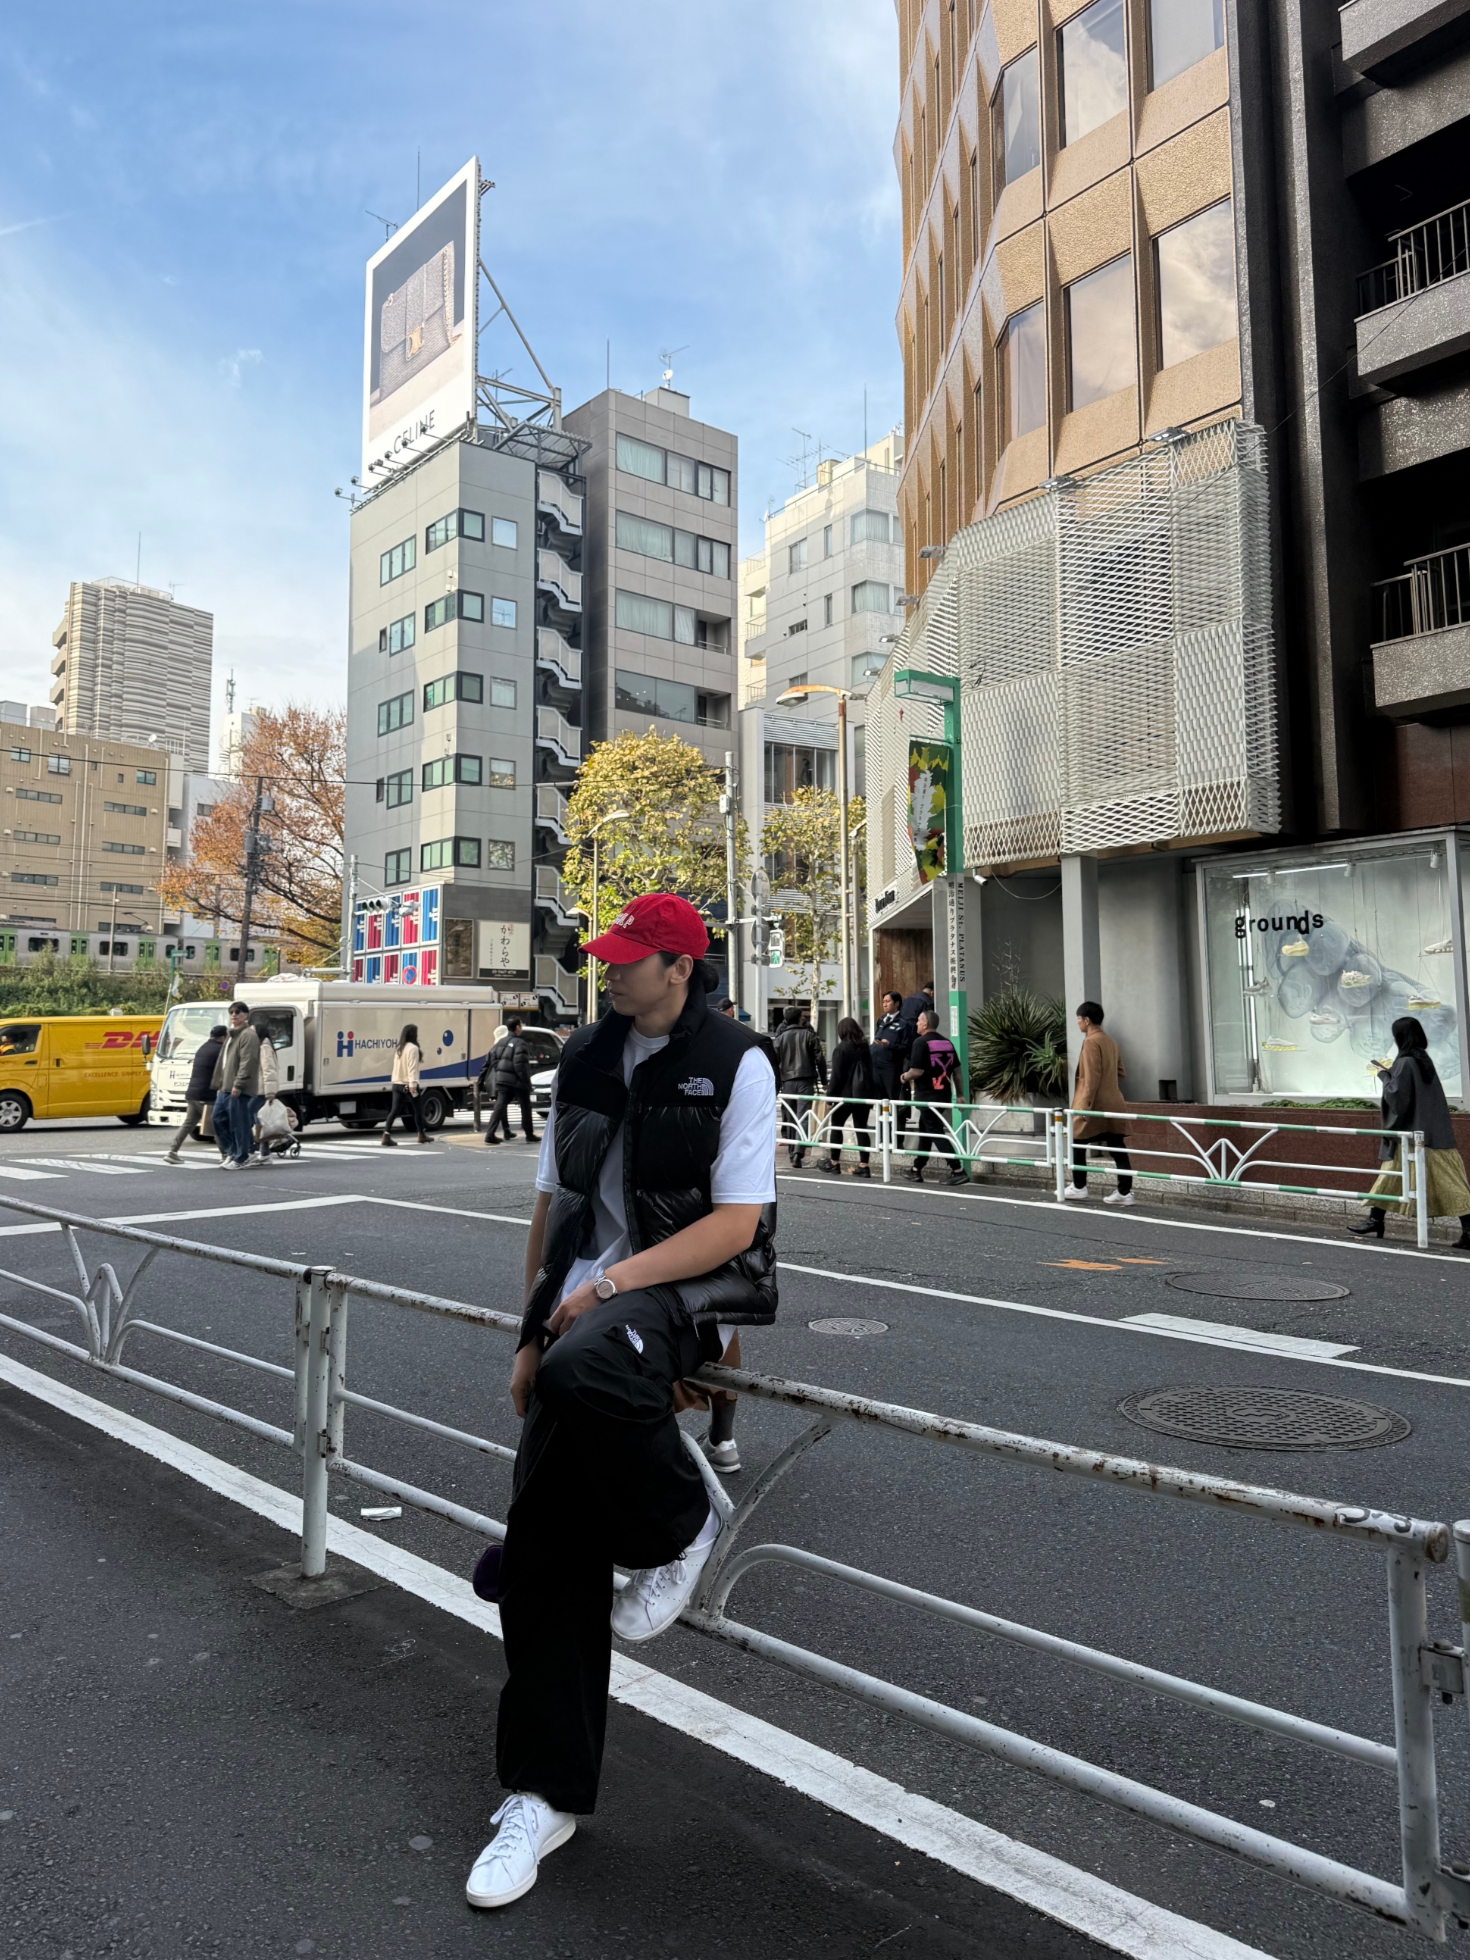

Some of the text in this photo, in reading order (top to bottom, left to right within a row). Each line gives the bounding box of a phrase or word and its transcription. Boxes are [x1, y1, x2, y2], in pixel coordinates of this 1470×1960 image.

[394, 409, 435, 454] CELINE
[1234, 910, 1324, 939] grounds
[500, 925, 511, 967] かわらや
[101, 1031, 161, 1049] DH
[354, 1039, 398, 1049] HACHIYOH
